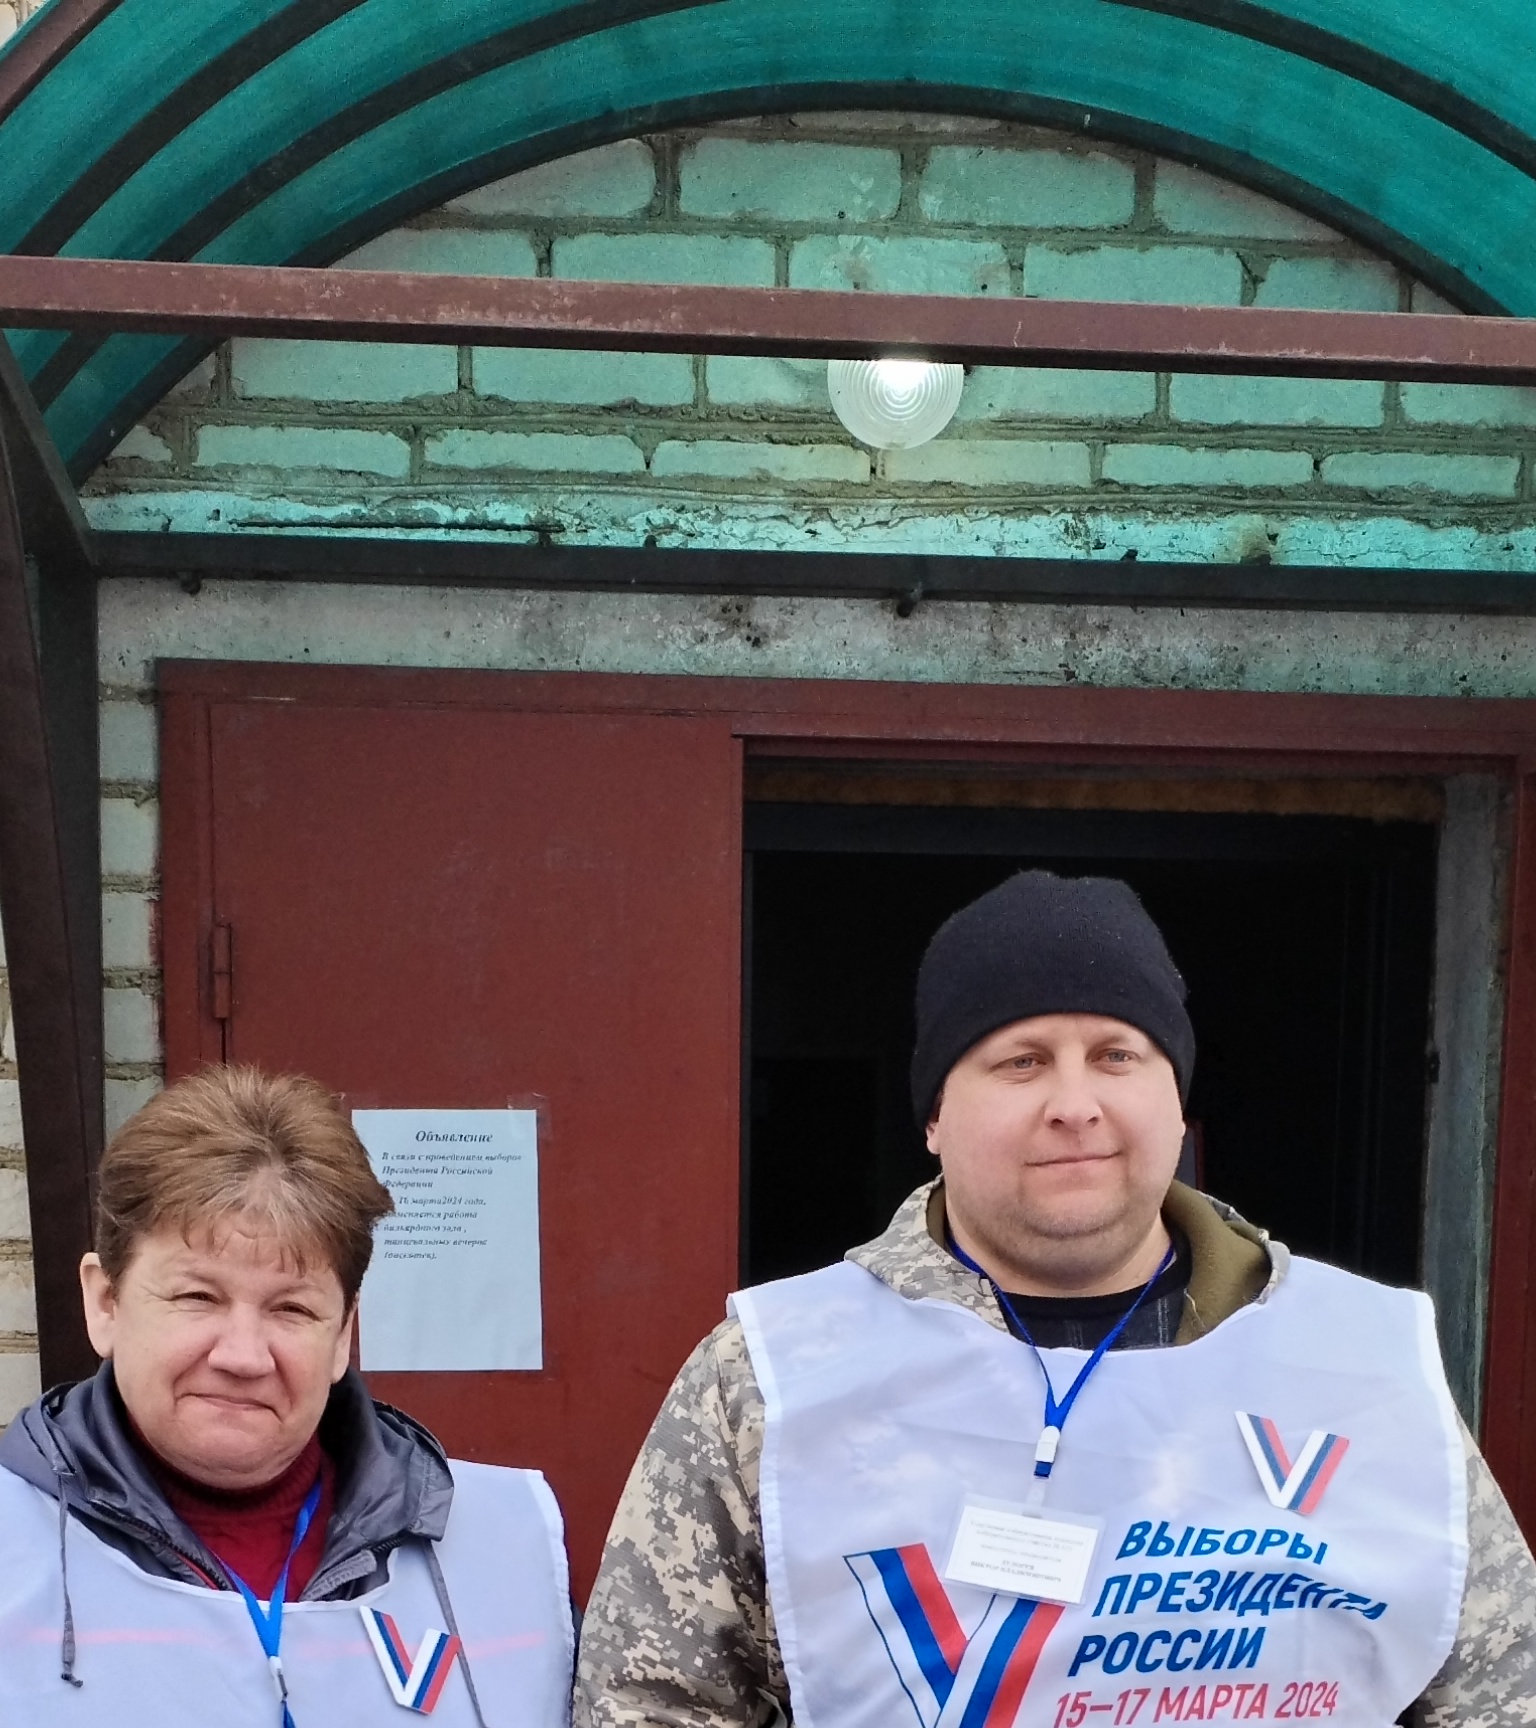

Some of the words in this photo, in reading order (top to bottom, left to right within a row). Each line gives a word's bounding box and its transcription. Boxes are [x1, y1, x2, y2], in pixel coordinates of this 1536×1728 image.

[415, 1130, 493, 1143] Объявление
[1115, 1520, 1329, 1565] ВЫБОРЫ
[1067, 1626, 1267, 1677] РОССИИ
[1152, 1683, 1270, 1723] МАРТА
[1273, 1680, 1340, 1719] 2024
